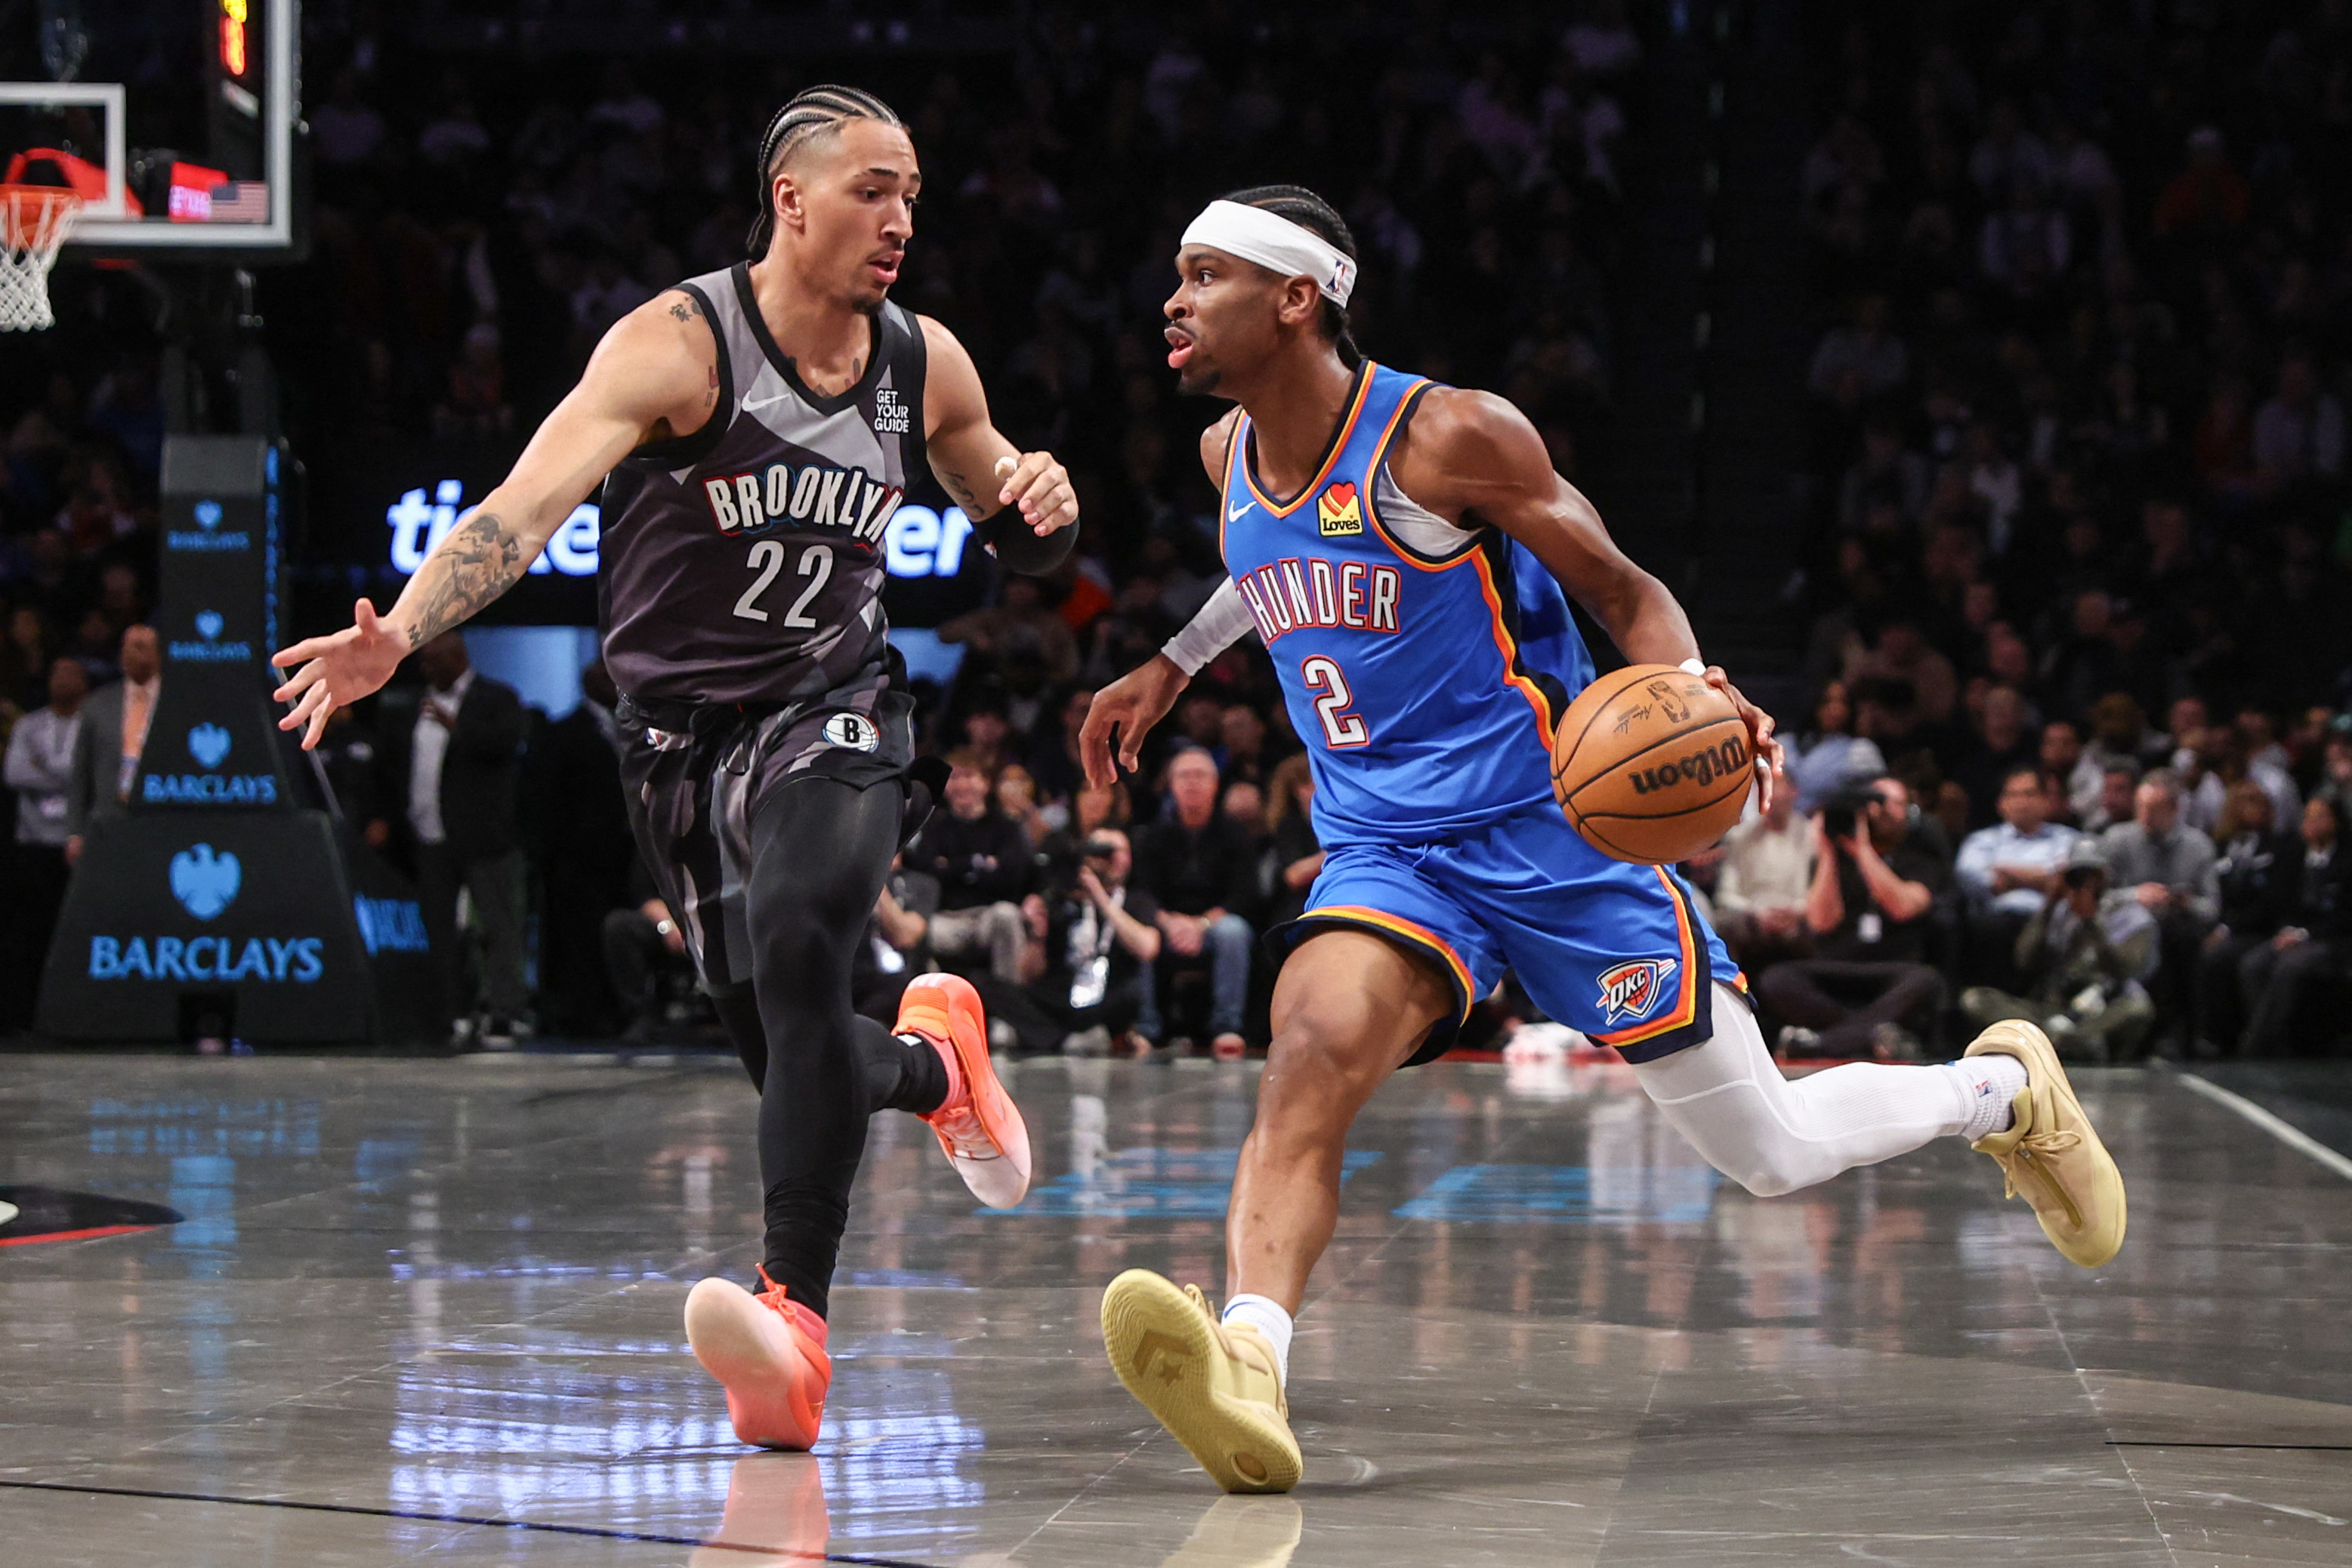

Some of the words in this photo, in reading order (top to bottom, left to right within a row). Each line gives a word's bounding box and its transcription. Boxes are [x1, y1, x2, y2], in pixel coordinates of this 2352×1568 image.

[876, 403, 909, 419] YOUR
[877, 390, 898, 404] GET
[875, 417, 909, 433] GUIDE
[705, 463, 904, 544] BROOKLYN
[733, 540, 833, 628] 22
[1237, 559, 1401, 644] HUNDER
[1301, 655, 1369, 748] 2
[843, 718, 860, 743] B
[142, 774, 277, 802] BARCLAYS
[89, 935, 323, 981] BARCLAYS
[1610, 968, 1646, 1014] OKC
